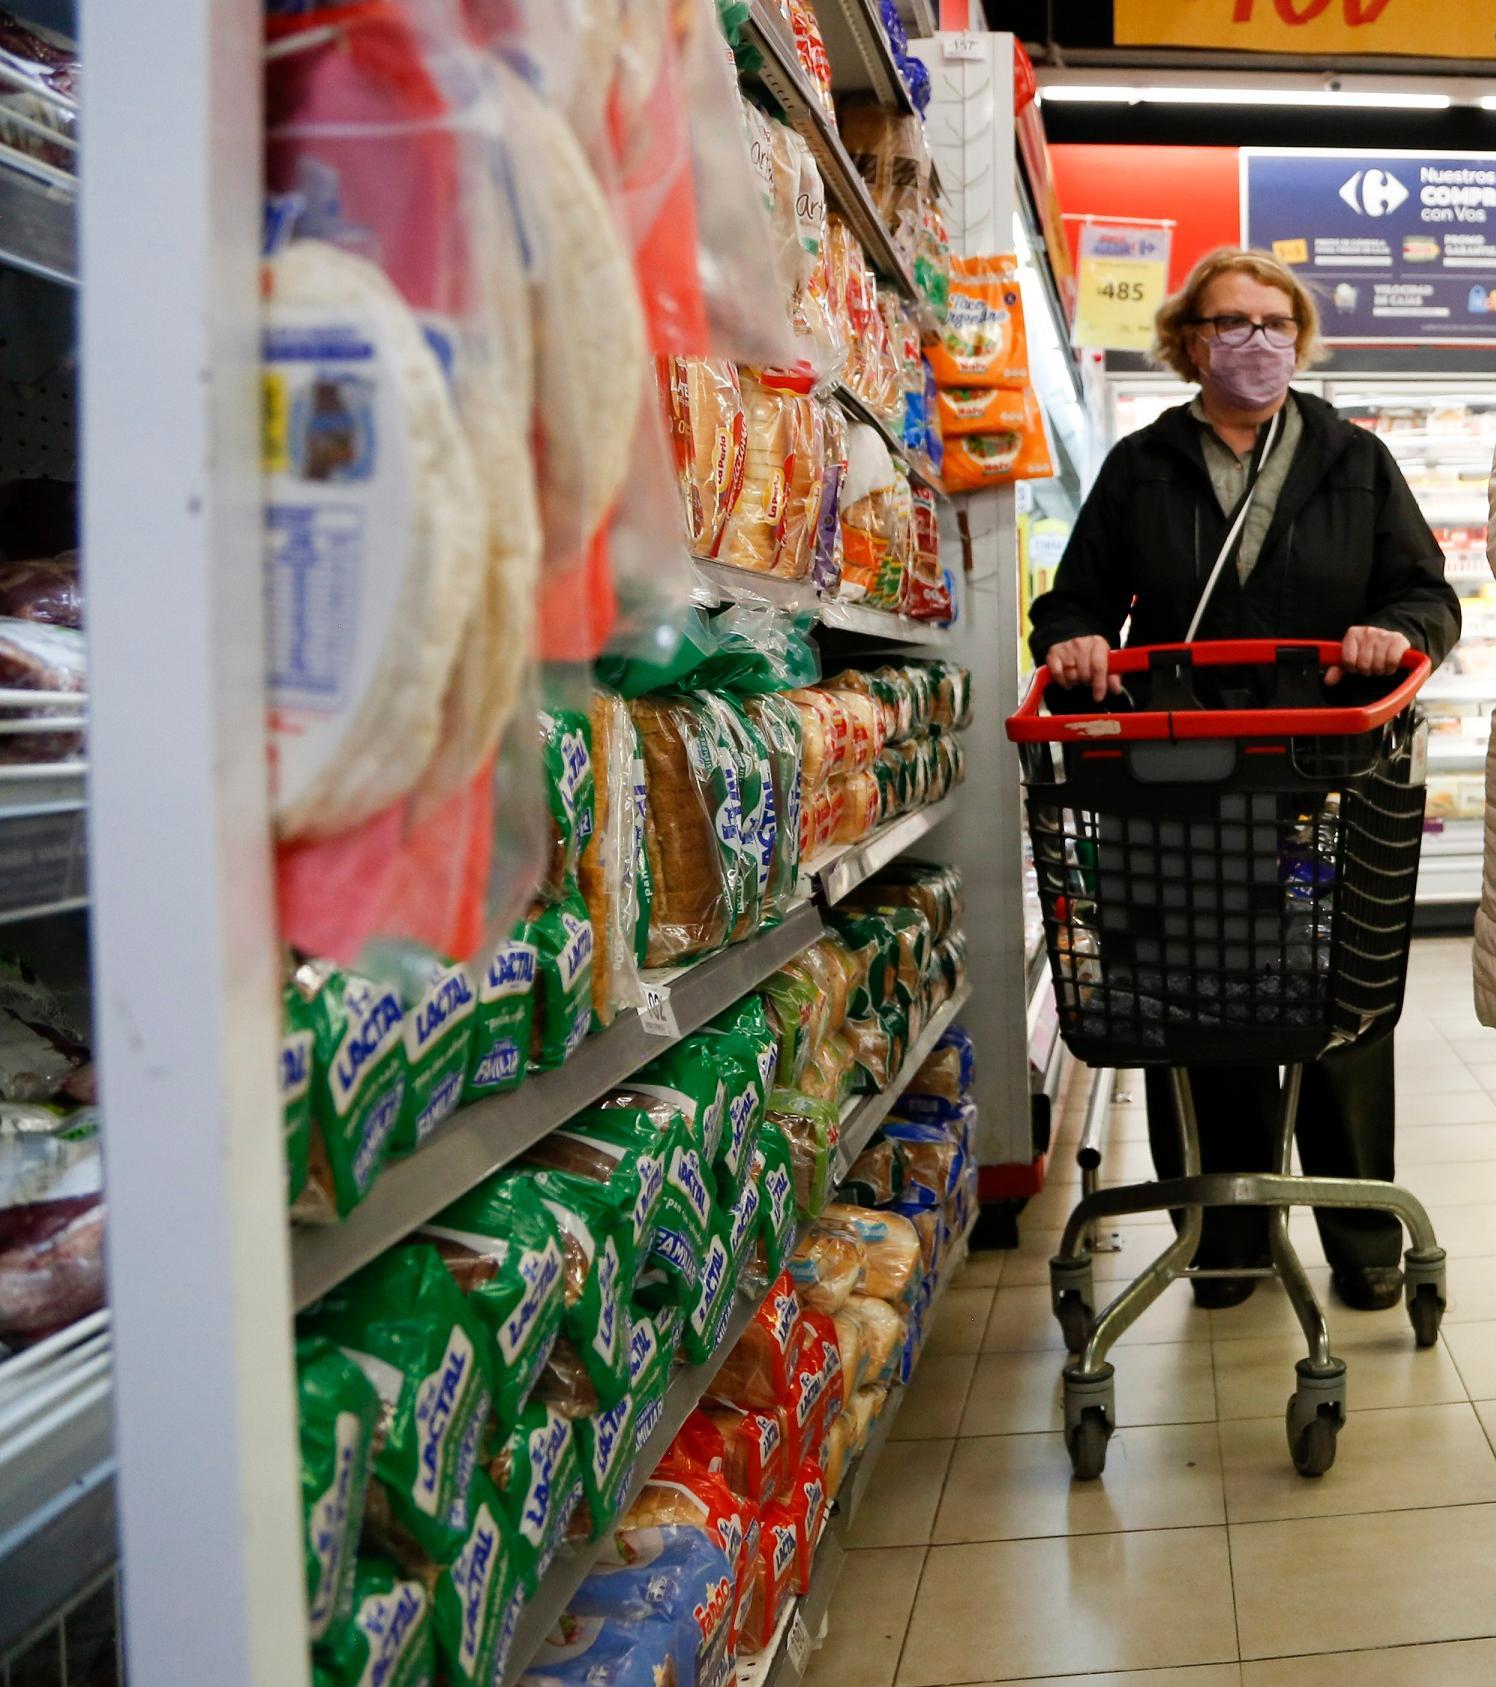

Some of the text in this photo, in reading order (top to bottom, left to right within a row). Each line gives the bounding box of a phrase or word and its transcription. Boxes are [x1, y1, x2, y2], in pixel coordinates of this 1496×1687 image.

[1420, 206, 1488, 223] con Vos
[488, 951, 534, 988] LACTAL
[415, 972, 473, 1046] LACTAL
